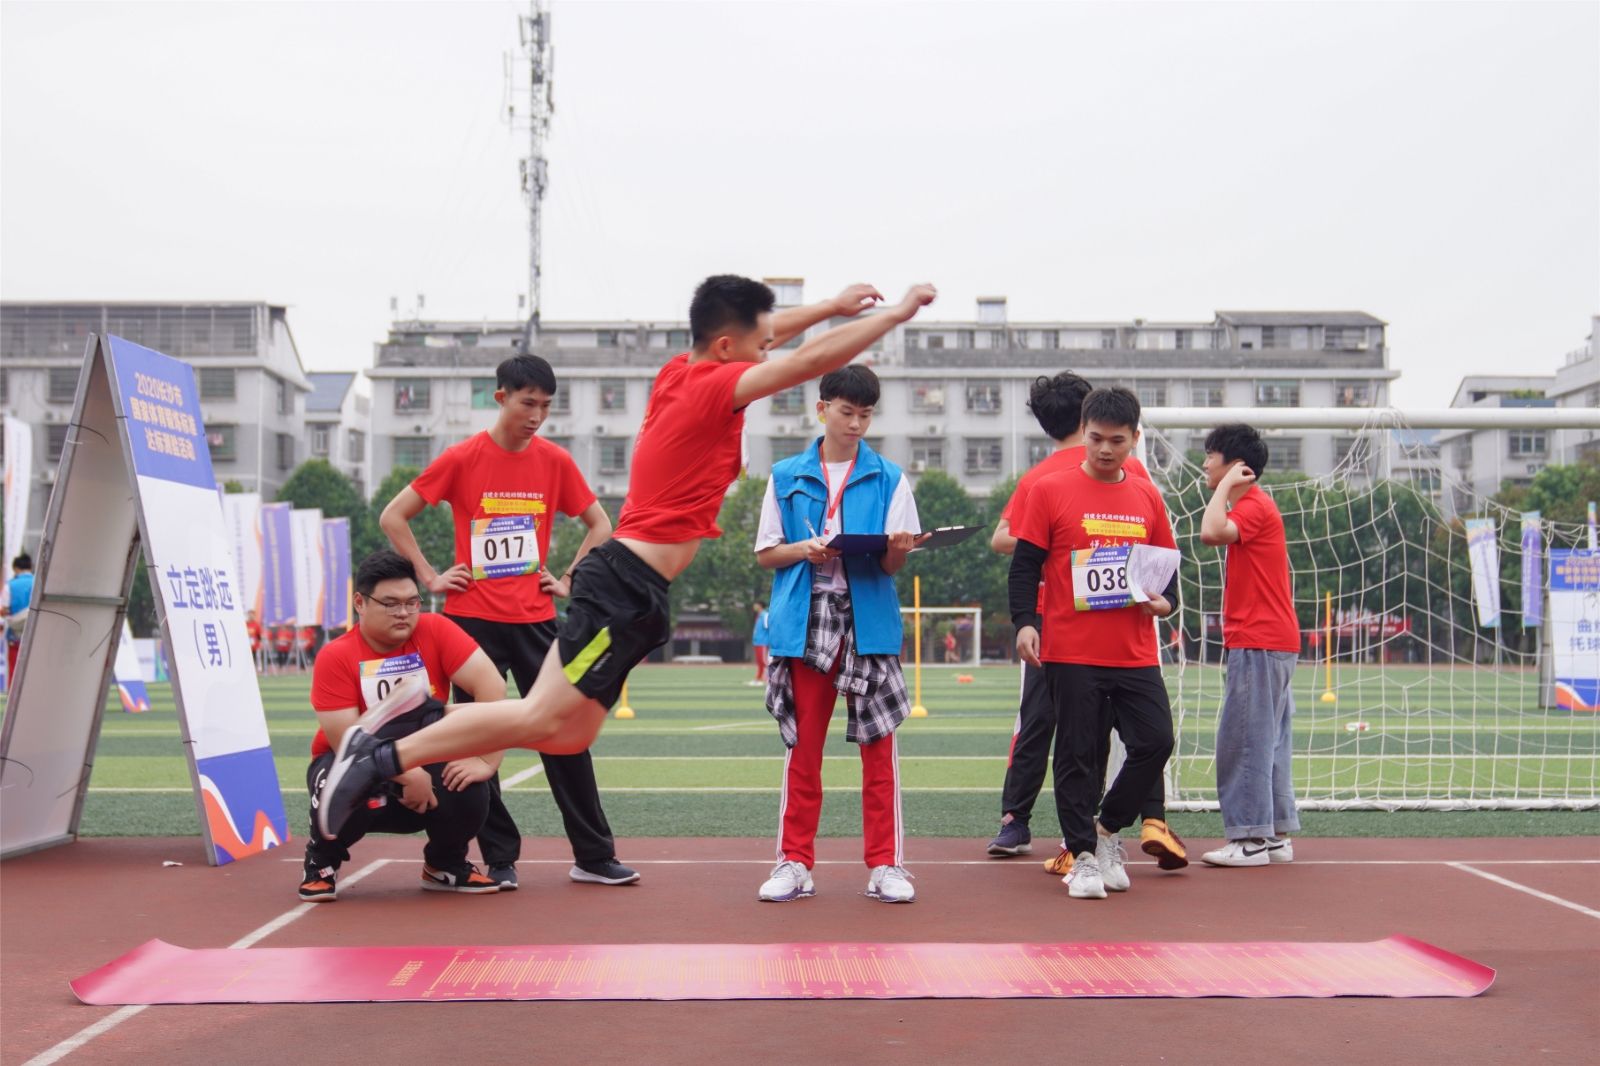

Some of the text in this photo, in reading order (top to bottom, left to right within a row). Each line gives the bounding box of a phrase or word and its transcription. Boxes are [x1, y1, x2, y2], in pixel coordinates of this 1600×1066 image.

[484, 535, 524, 561] 017
[166, 564, 234, 611] 立定跳远
[1087, 567, 1128, 592] 038
